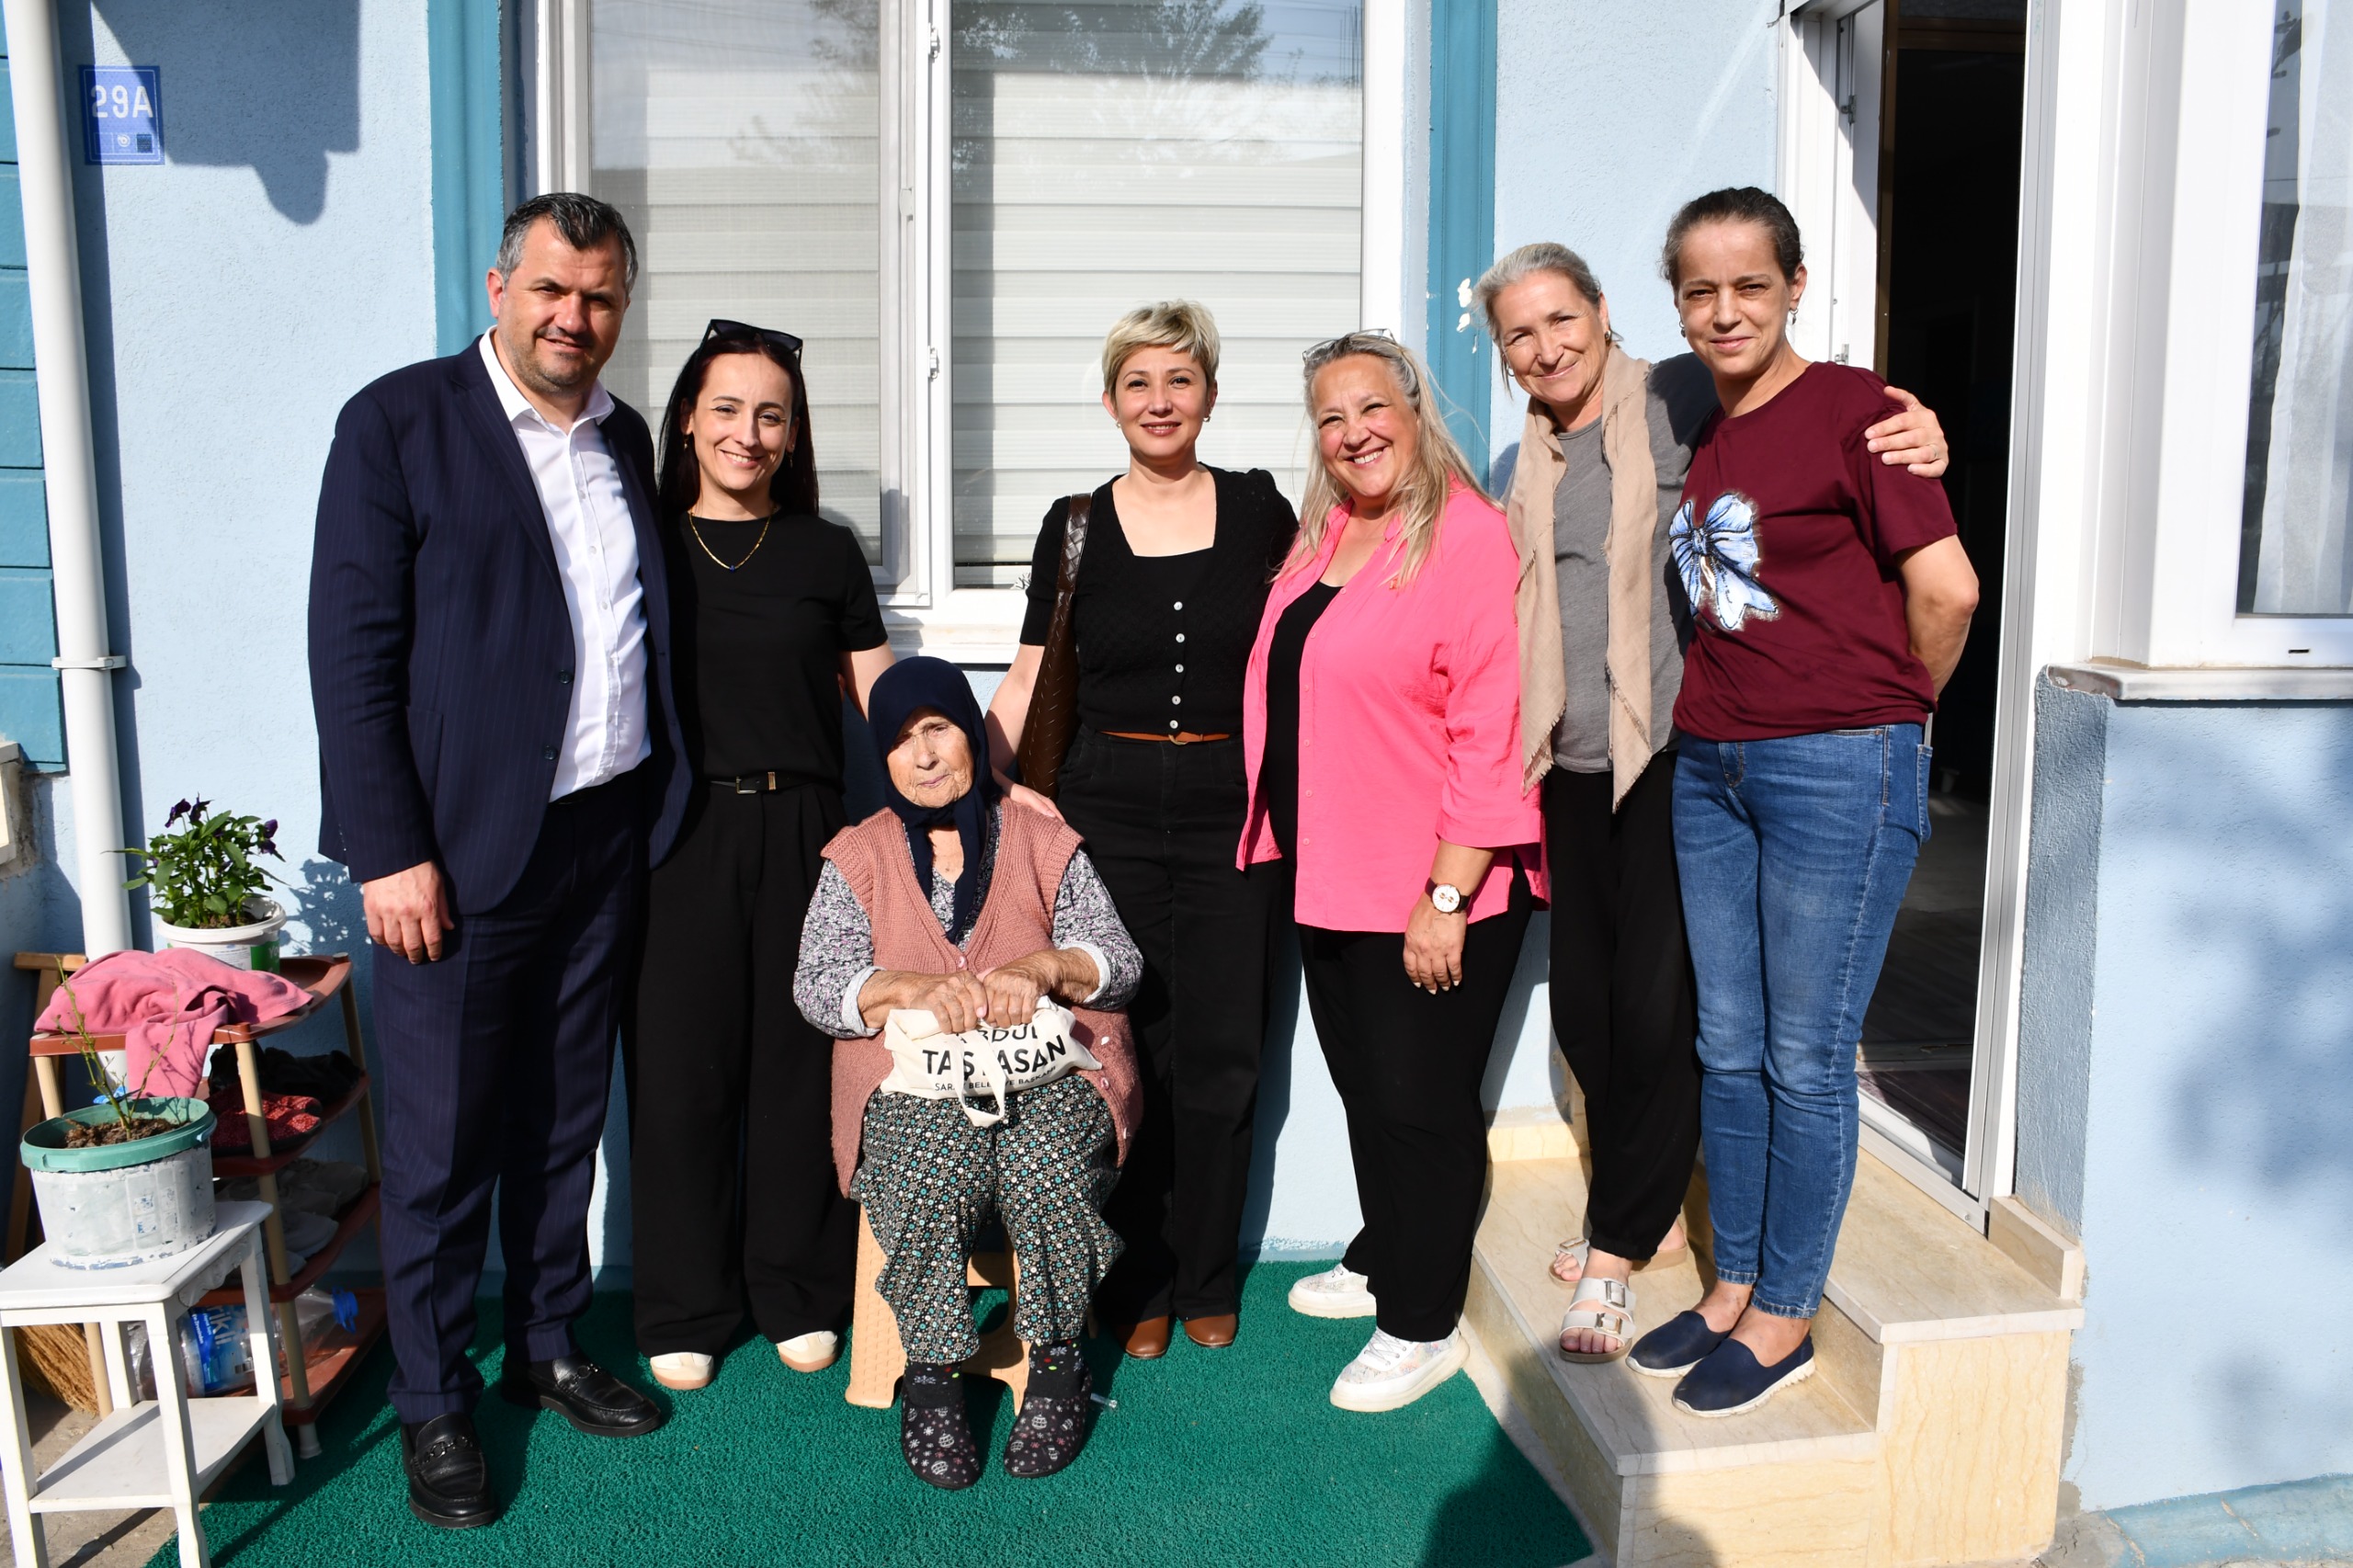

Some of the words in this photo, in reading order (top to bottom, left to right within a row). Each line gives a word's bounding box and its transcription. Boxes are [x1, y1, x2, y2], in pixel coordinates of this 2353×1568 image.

[90, 85, 153, 119] 29A
[922, 1035, 1066, 1081] TAŞASAN
[206, 1305, 237, 1345] rikli
